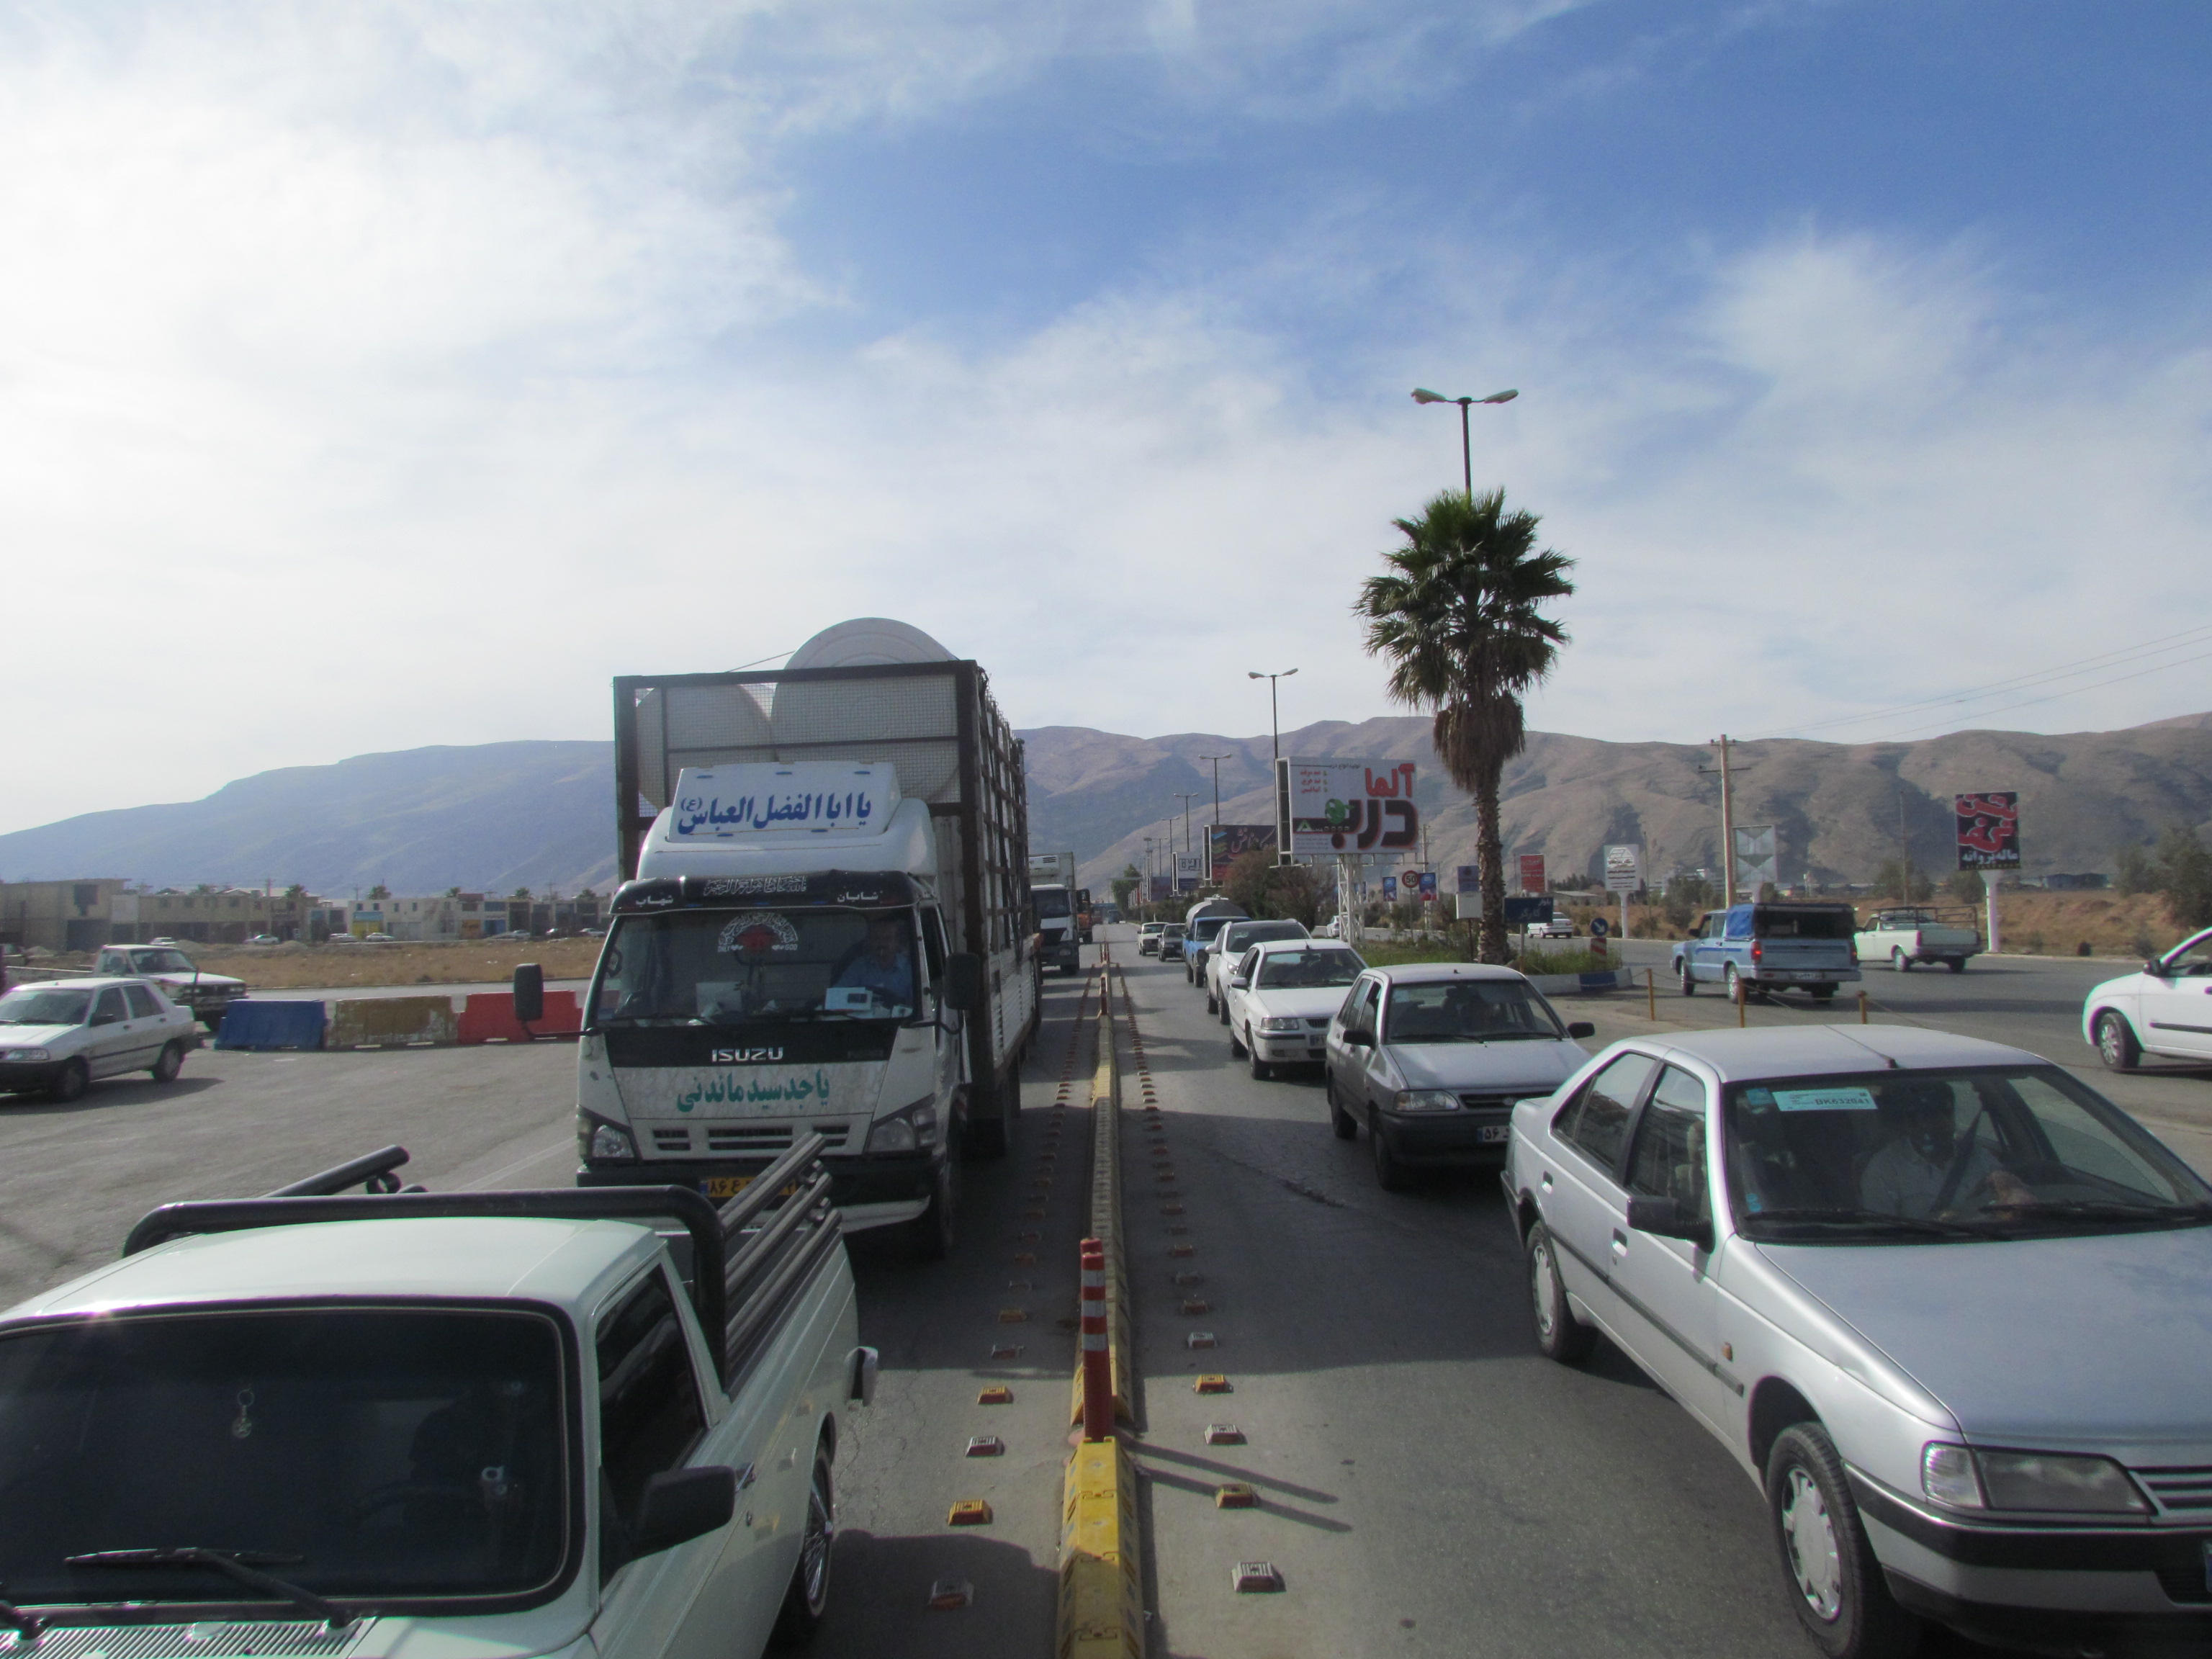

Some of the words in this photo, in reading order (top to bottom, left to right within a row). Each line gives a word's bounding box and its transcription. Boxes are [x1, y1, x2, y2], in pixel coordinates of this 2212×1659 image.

[1364, 763, 1415, 798] آلما
[678, 796, 755, 835] العباس
[856, 791, 872, 826] یا
[1406, 875, 1416, 884] 50
[636, 894, 674, 907] شهاب
[711, 1047, 783, 1062] ISUZU
[747, 1079, 782, 1110] سید
[816, 1069, 830, 1106] یا
